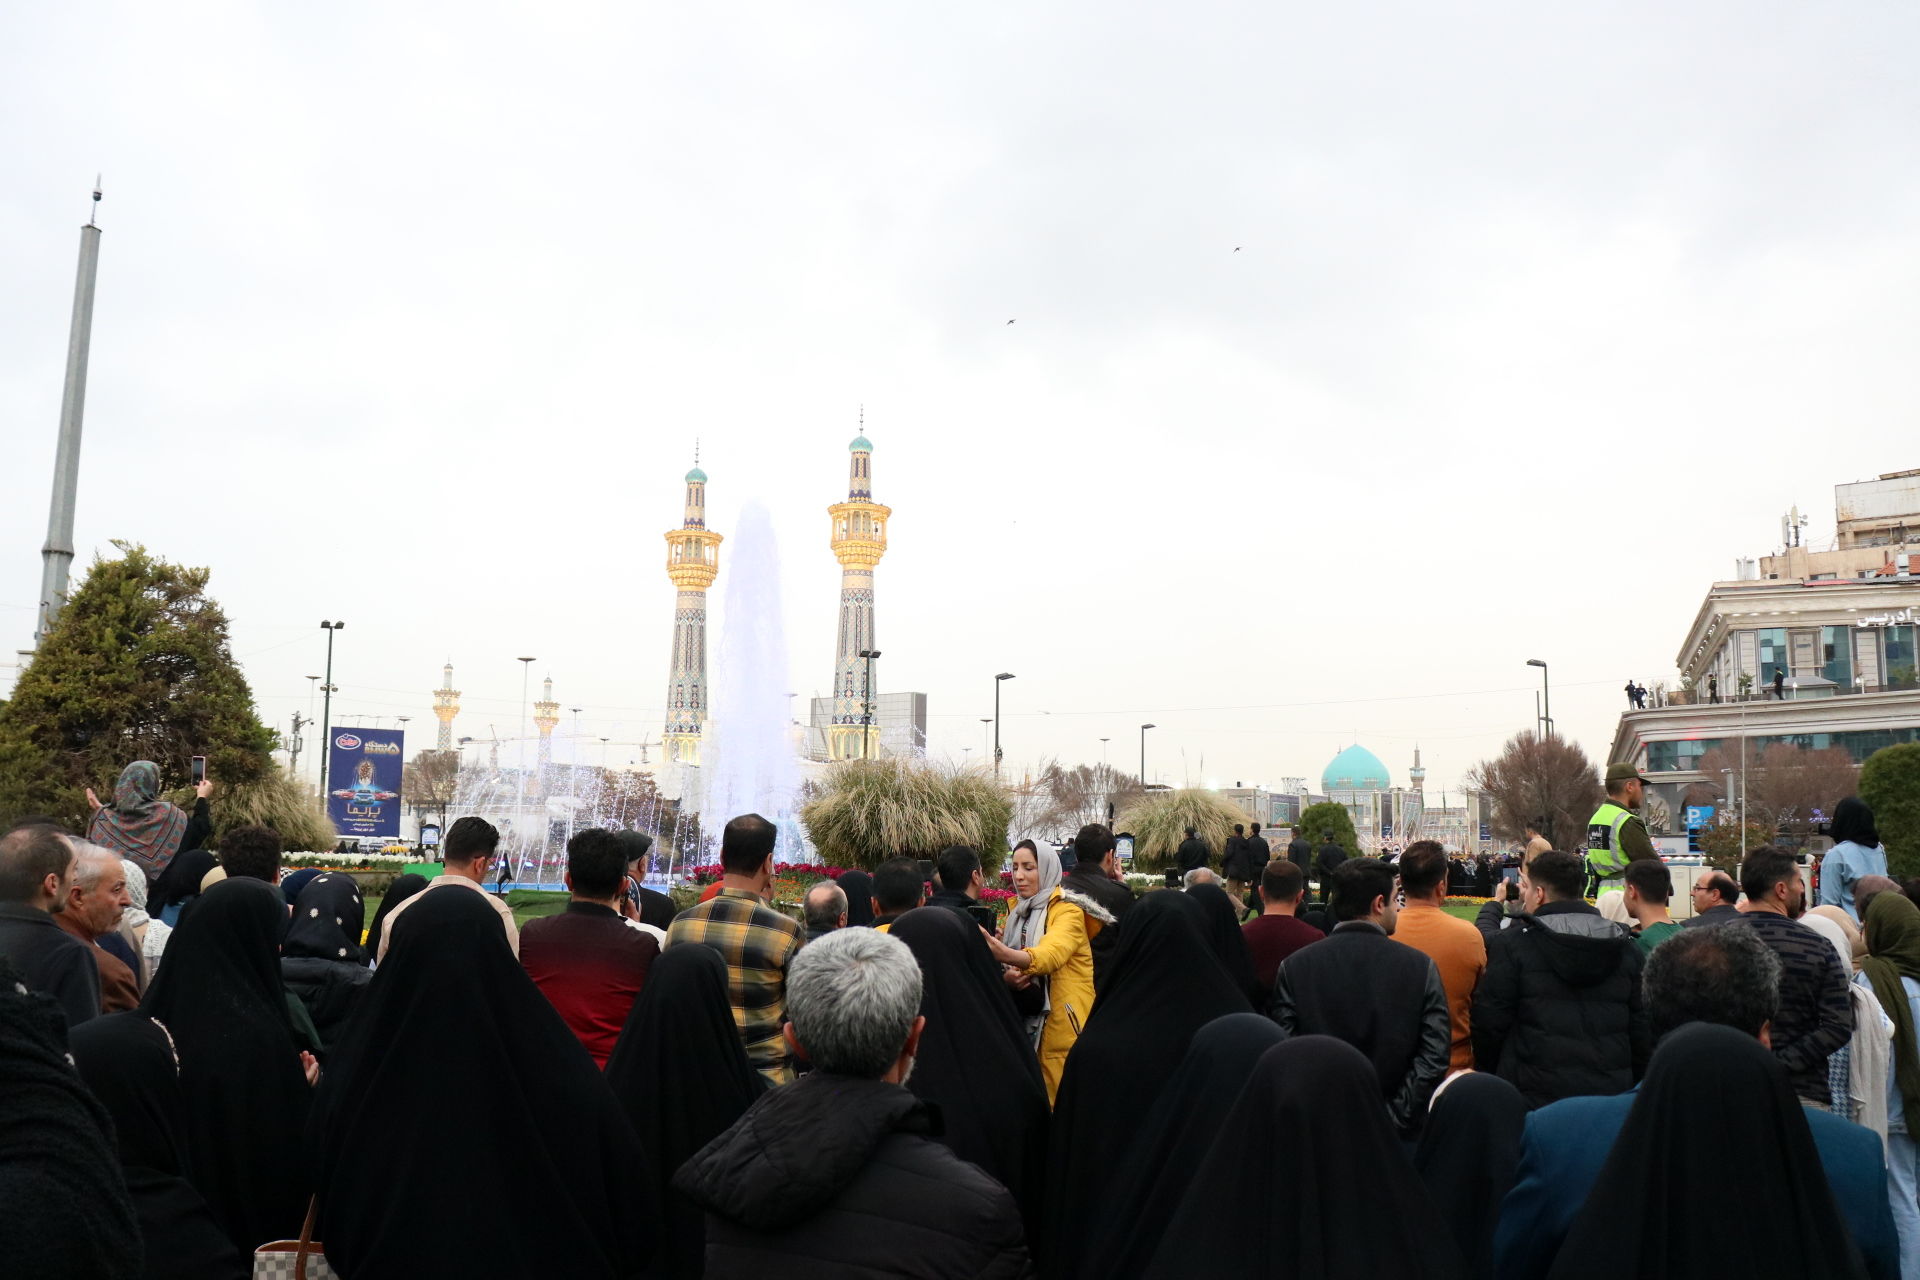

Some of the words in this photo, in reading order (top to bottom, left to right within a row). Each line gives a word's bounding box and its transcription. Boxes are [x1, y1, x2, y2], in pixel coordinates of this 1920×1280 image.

[1857, 607, 1911, 627] ادریس
[347, 803, 381, 818] پریما
[1688, 808, 1701, 824] P
